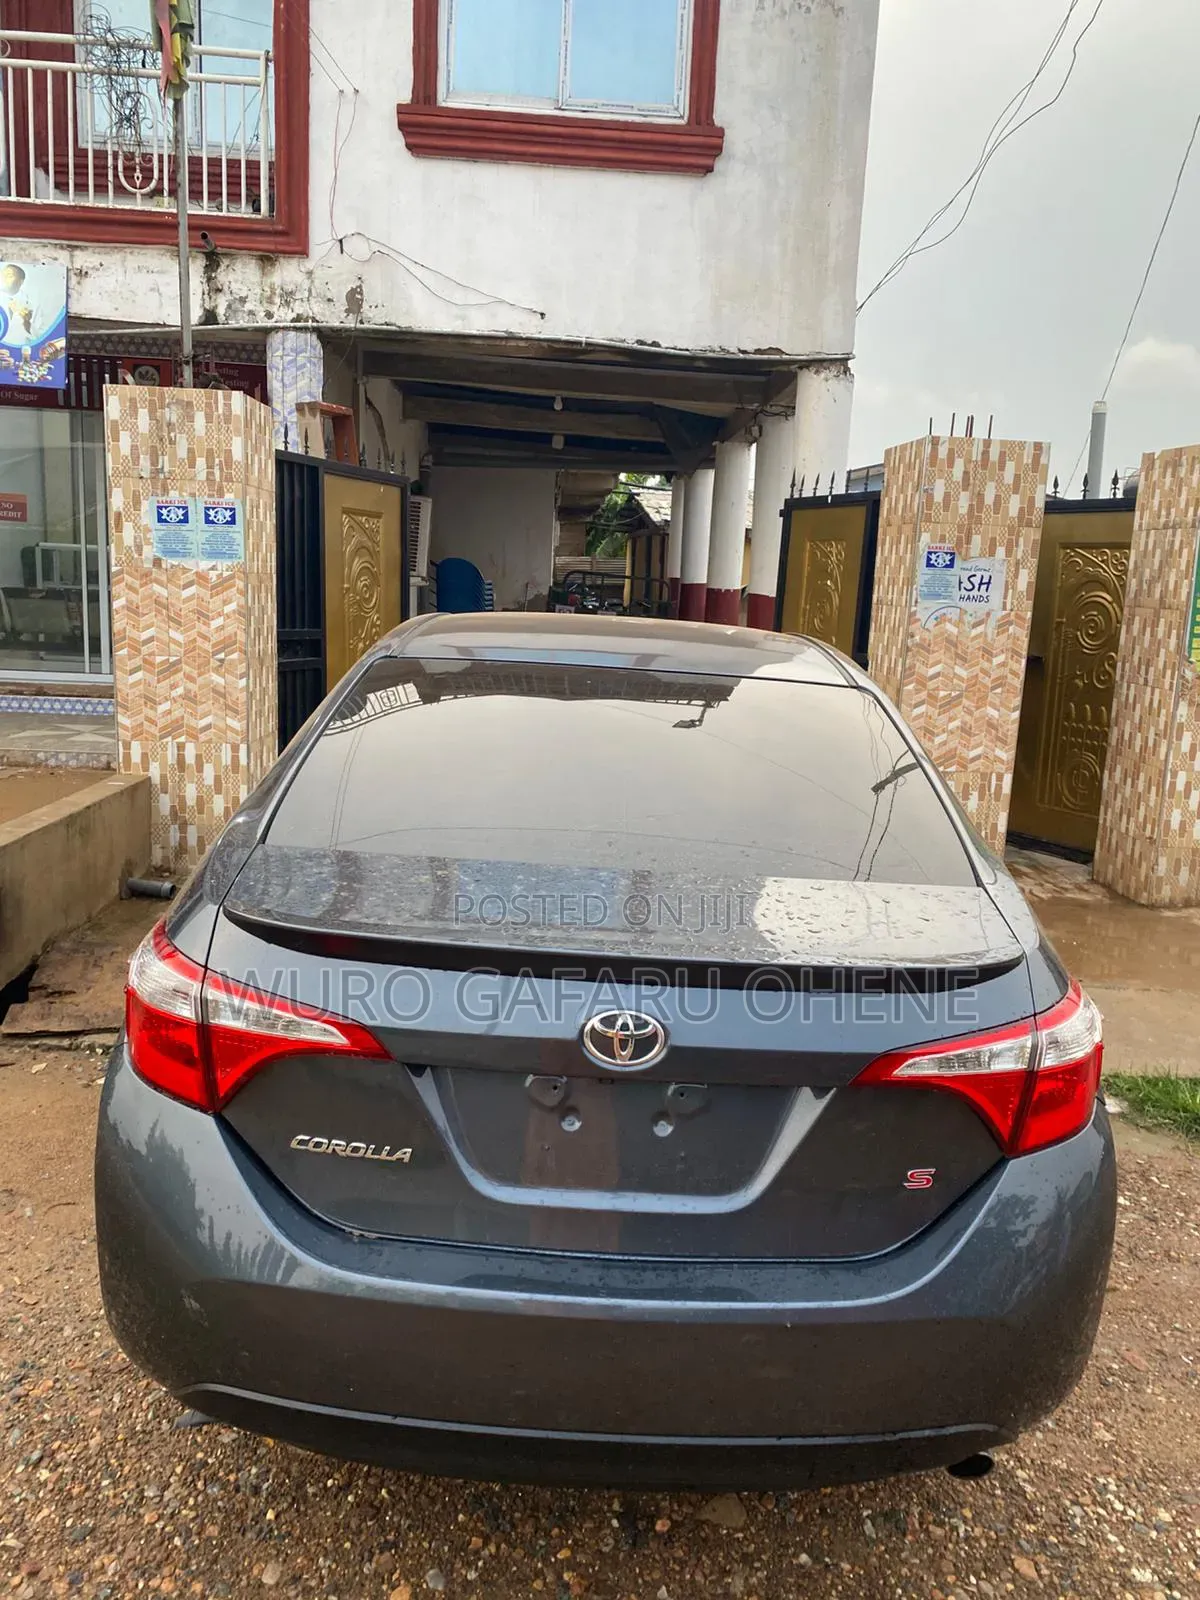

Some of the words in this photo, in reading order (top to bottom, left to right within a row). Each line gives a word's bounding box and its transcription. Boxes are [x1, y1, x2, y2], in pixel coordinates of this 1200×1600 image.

[958, 594, 990, 603] HANDS
[289, 1134, 413, 1163] COROLLA
[903, 1168, 936, 1189] S
